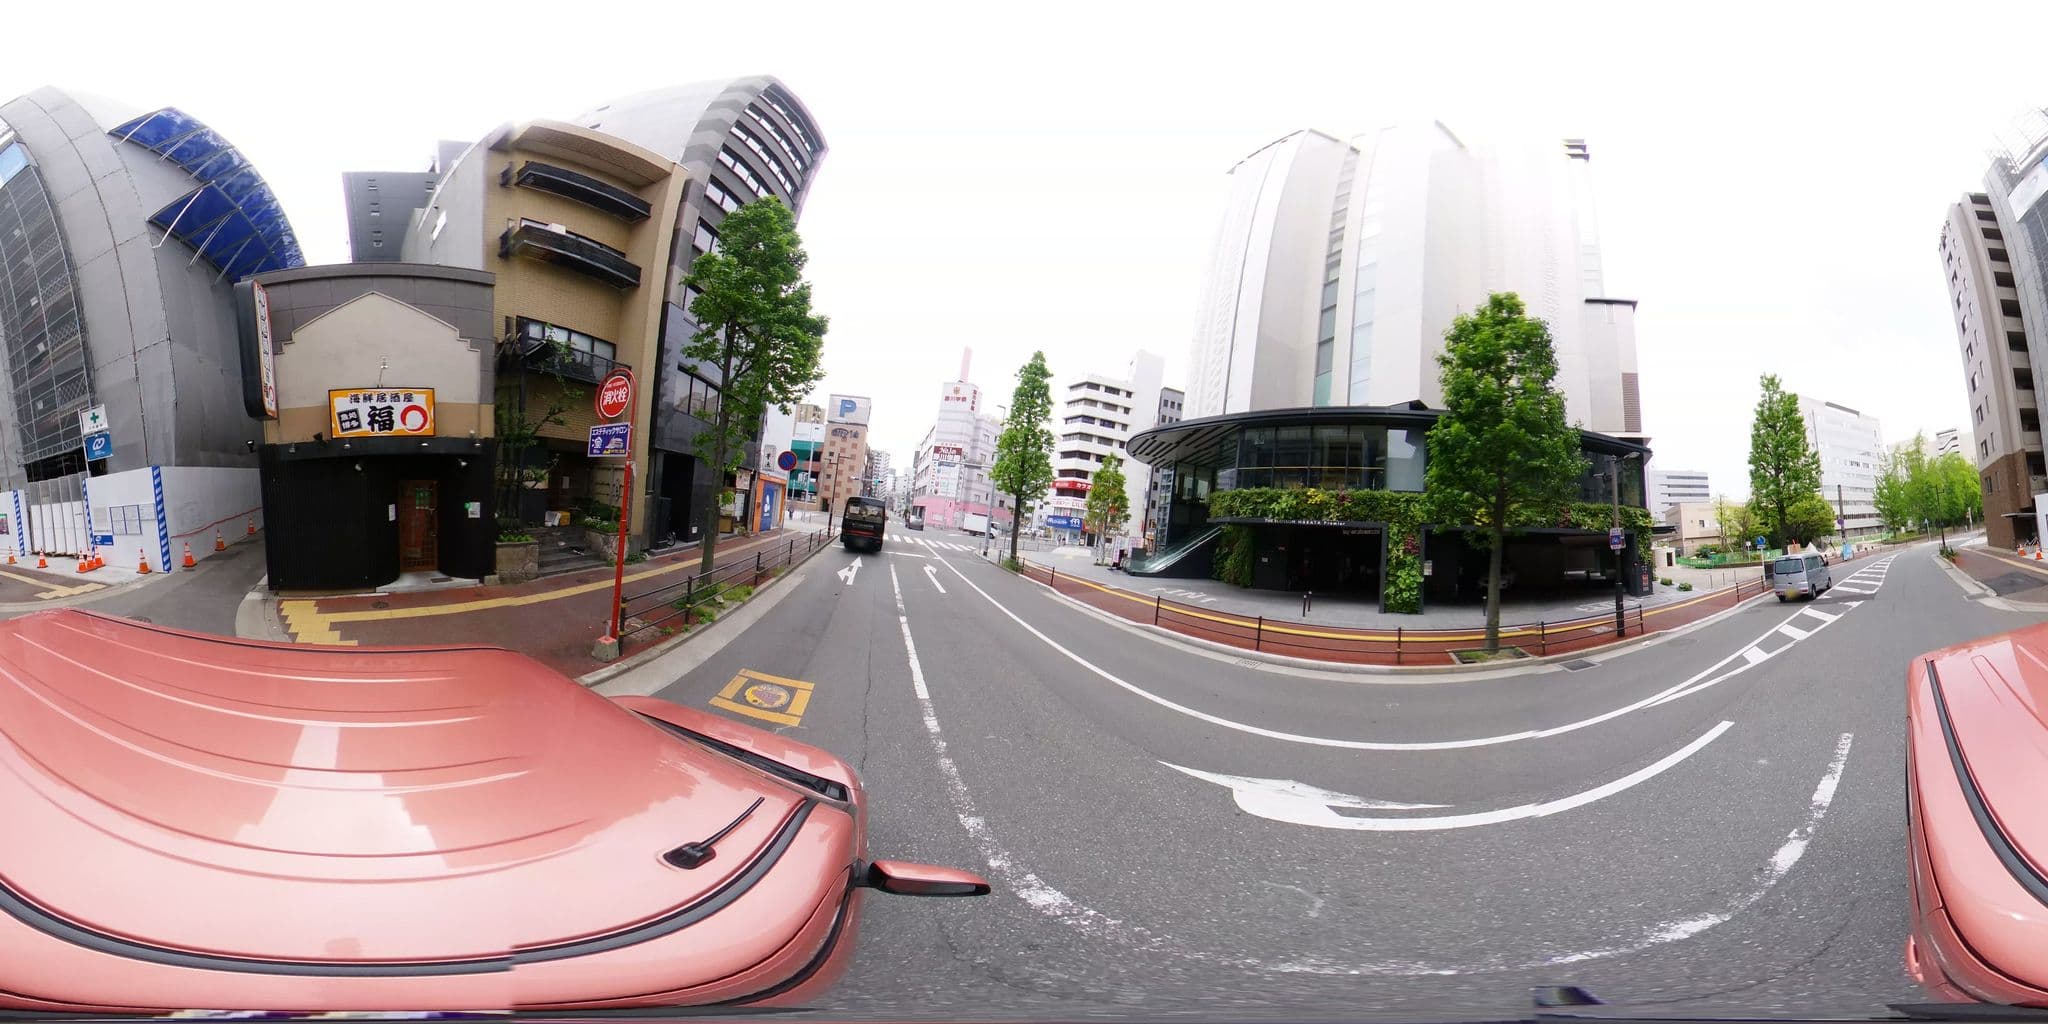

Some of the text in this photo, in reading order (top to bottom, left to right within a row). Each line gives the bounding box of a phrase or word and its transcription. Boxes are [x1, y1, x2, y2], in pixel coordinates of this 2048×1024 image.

[349, 392, 414, 404] 海鮮居酒屋
[603, 387, 628, 405] 消火栓
[839, 399, 857, 418] P
[367, 405, 395, 432] 福
